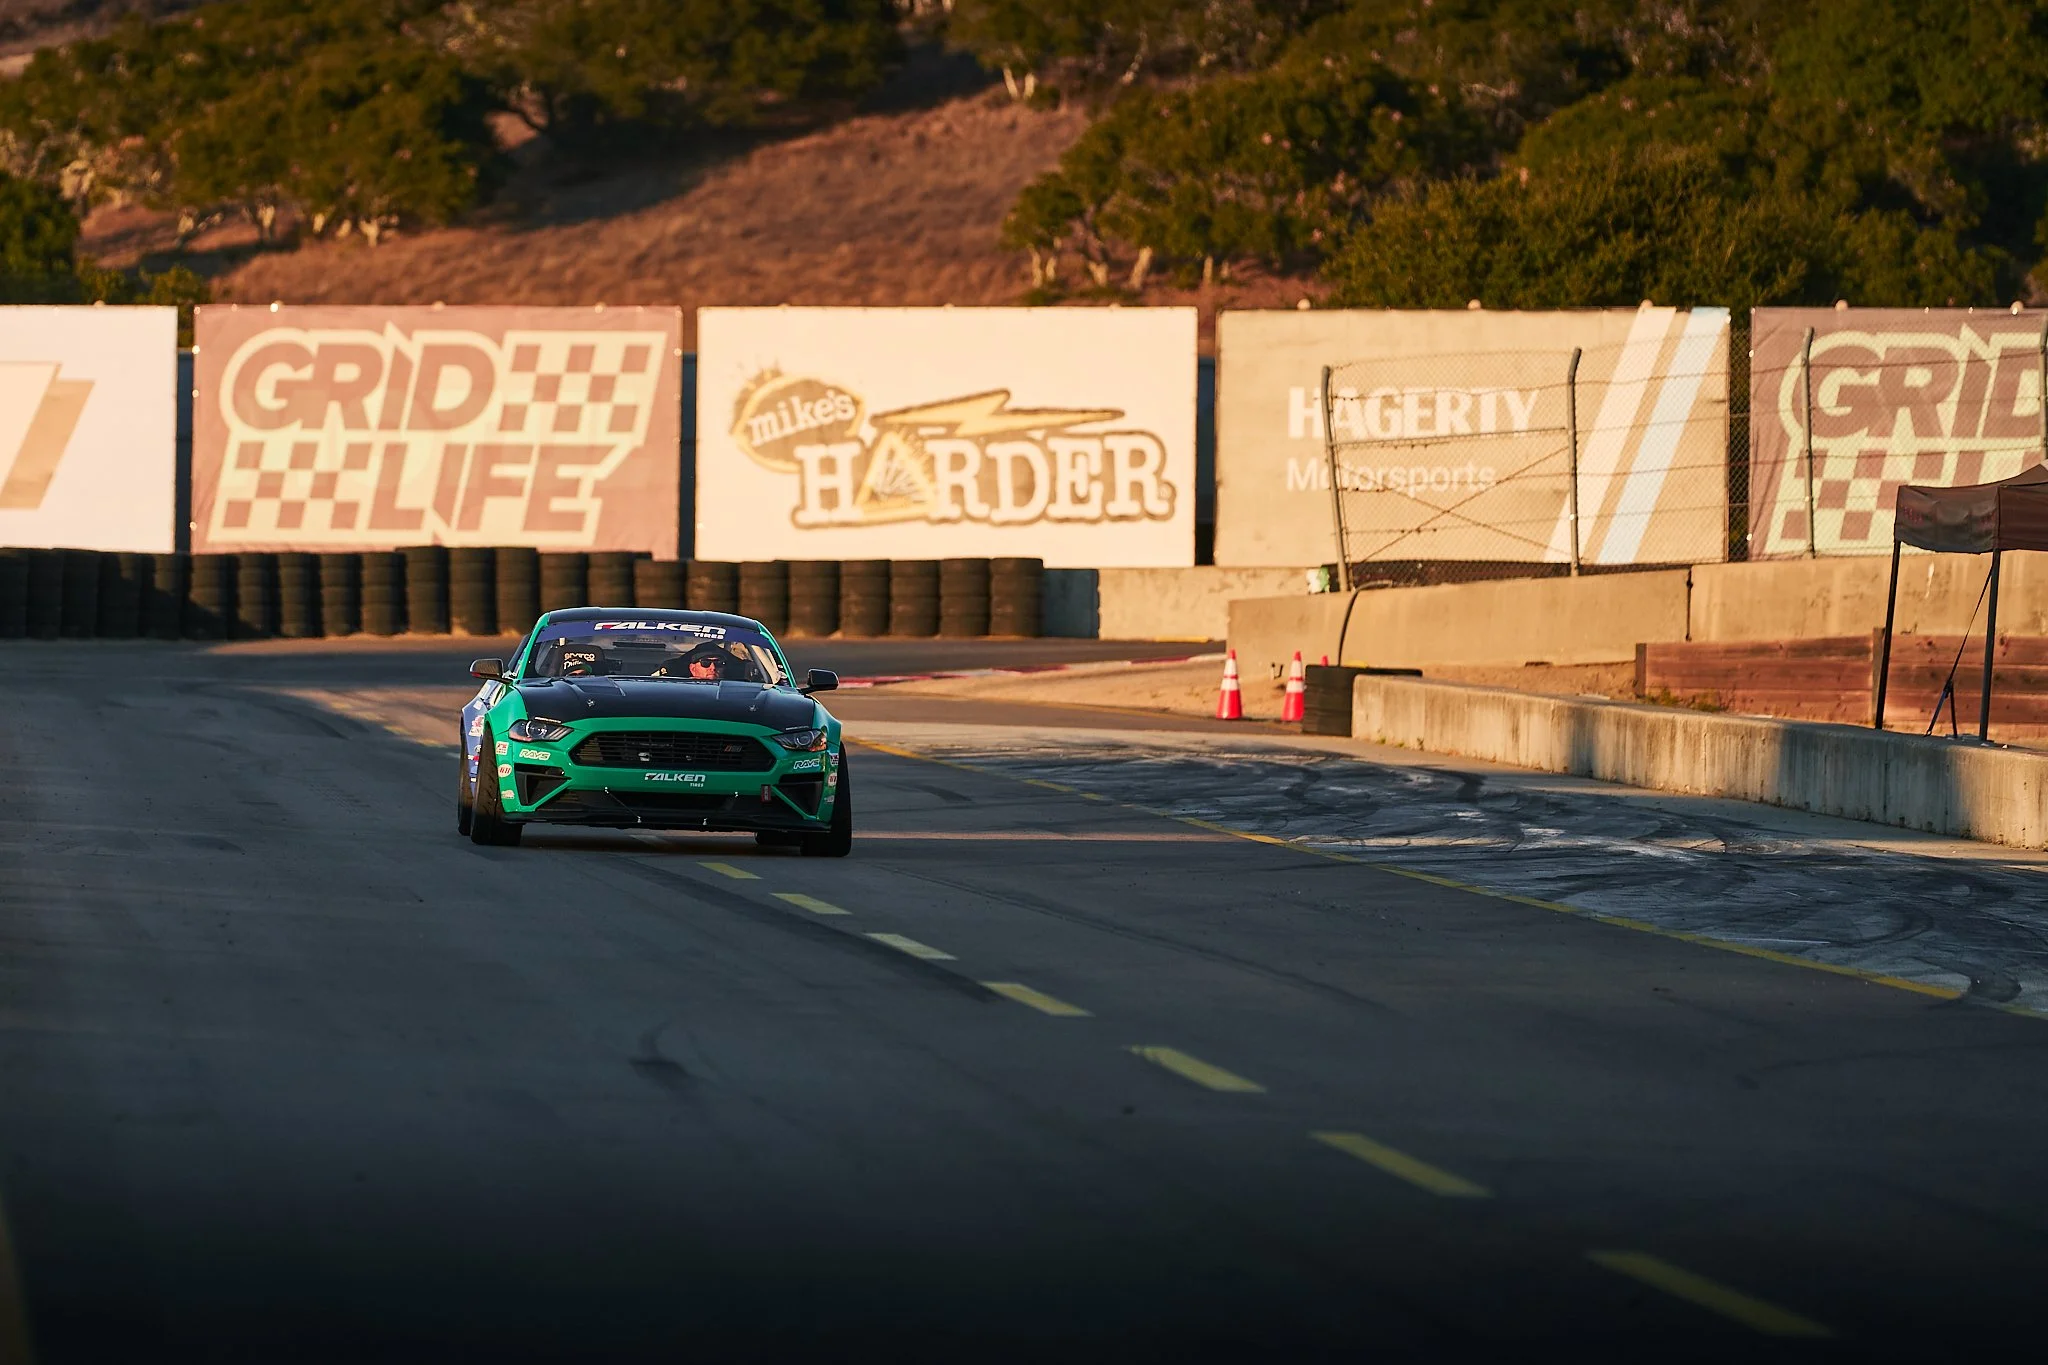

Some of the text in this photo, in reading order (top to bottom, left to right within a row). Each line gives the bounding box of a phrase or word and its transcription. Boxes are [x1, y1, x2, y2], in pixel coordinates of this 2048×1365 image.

[232, 340, 497, 431] GRID
[747, 391, 856, 446] mike's
[1287, 386, 1541, 440] HAGERTY
[366, 442, 617, 533] LIFE
[793, 431, 1176, 526] HARDER
[1286, 456, 1498, 498] Motorsports
[594, 621, 727, 635] FALKEN
[519, 748, 551, 760] RAYS
[644, 772, 706, 782] FALKEN
